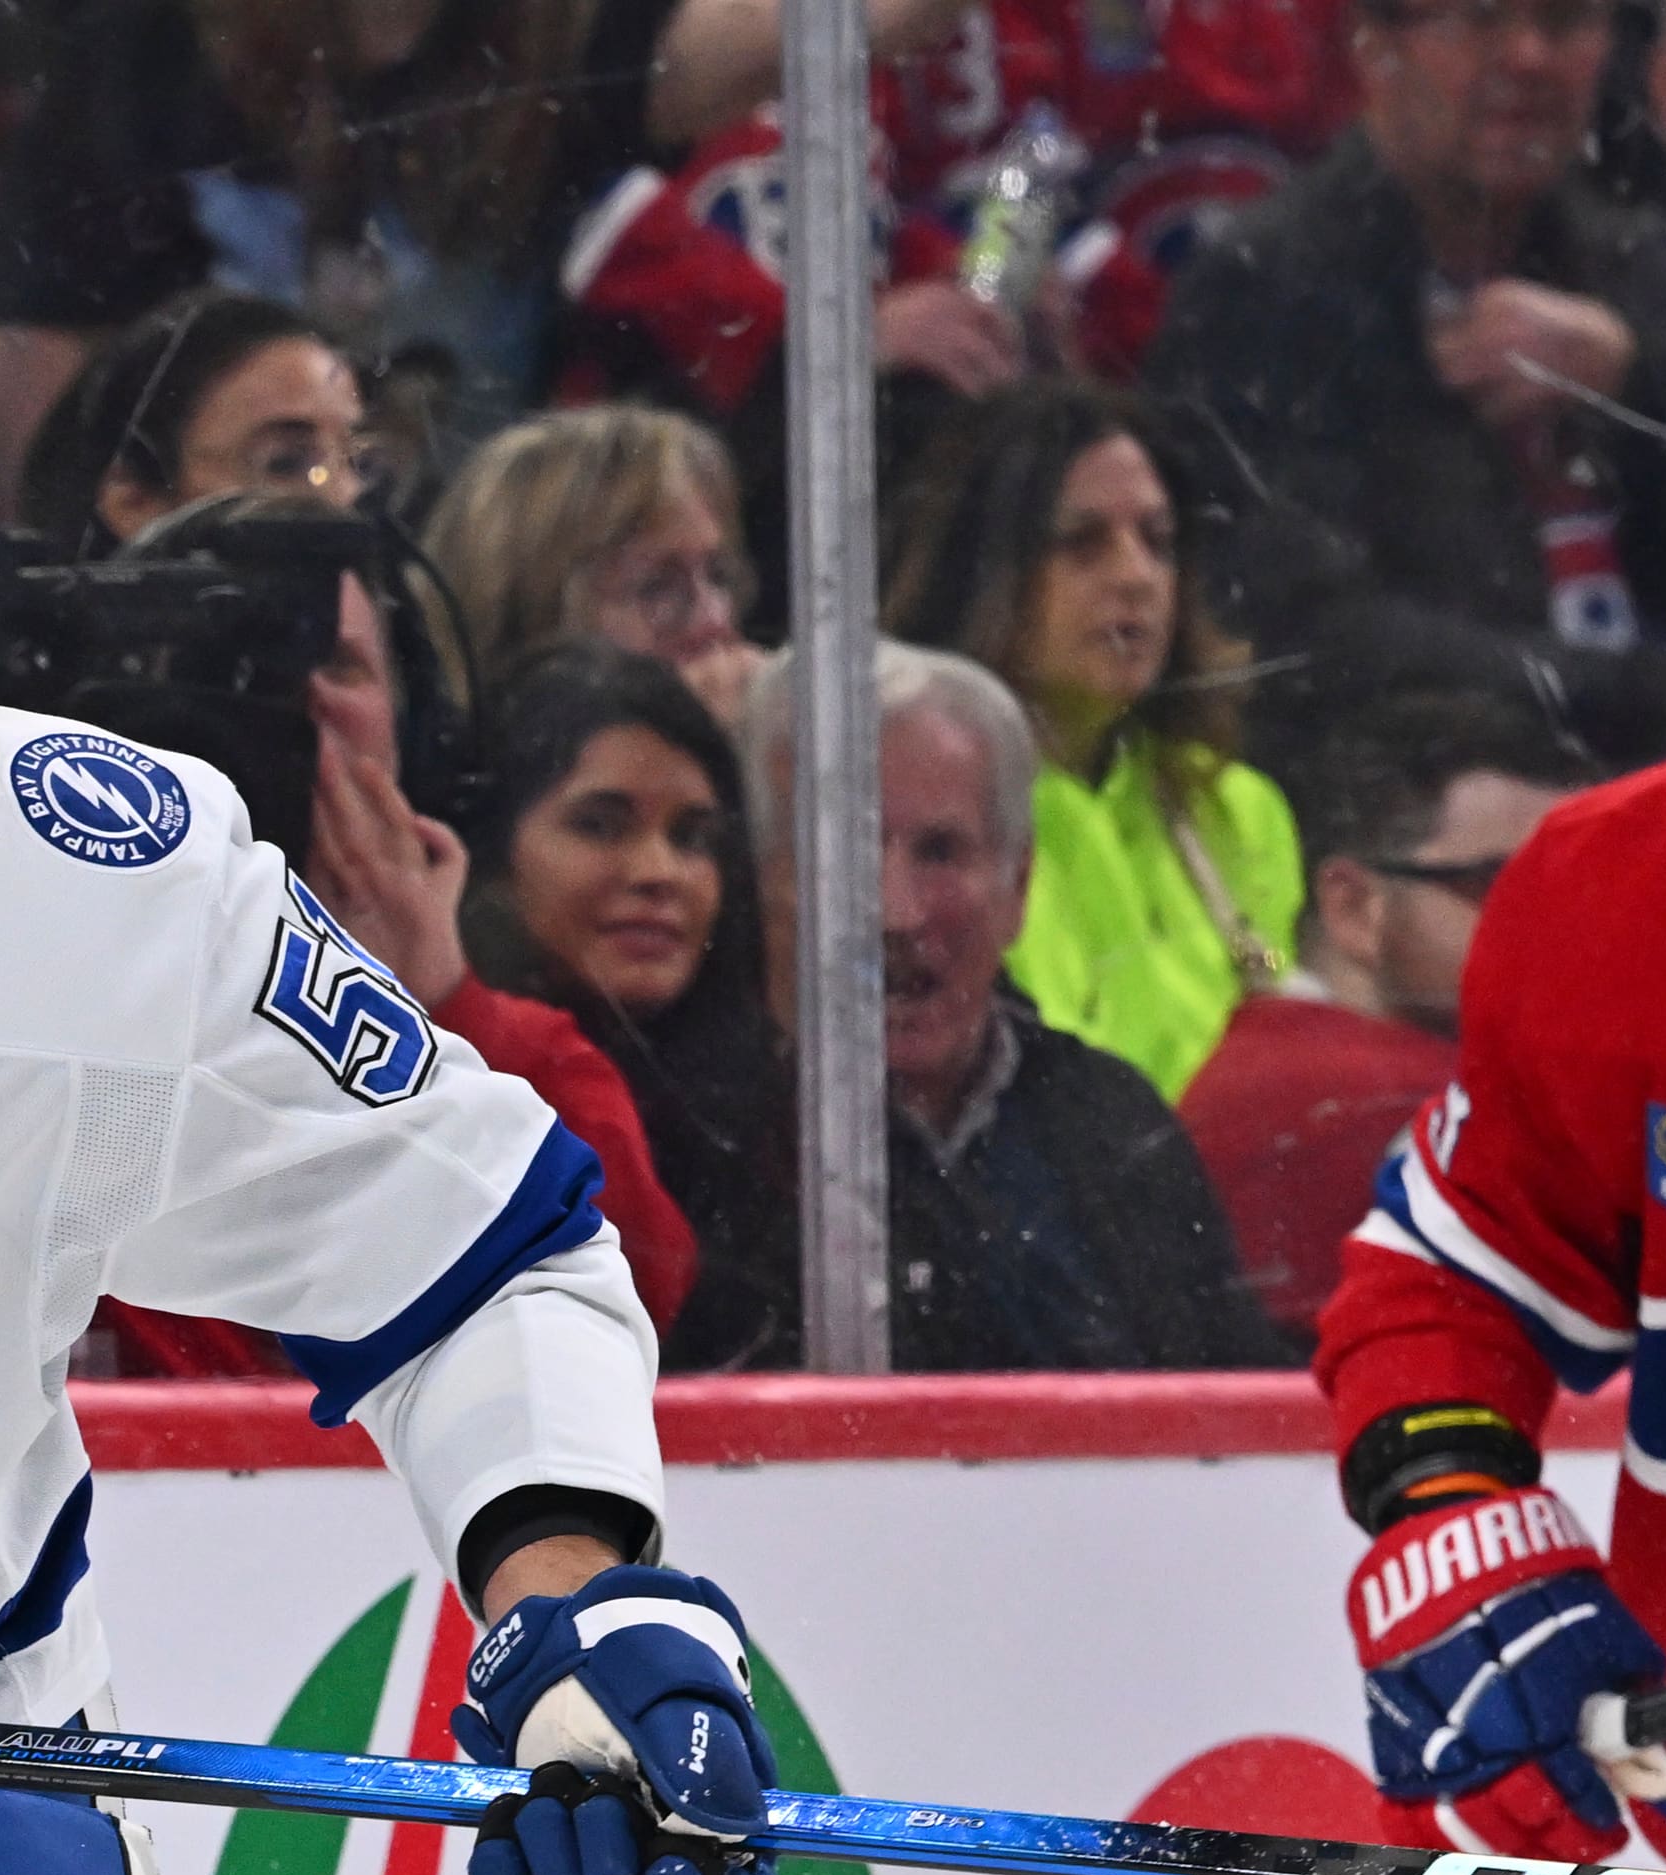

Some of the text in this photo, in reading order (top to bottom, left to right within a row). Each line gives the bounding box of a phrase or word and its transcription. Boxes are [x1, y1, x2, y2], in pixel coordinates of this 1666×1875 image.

[15, 735, 157, 861] TAMPA BAY LIGHTNING
[158, 792, 175, 831] HOCKEY
[171, 803, 186, 828] CLUB
[471, 1611, 523, 1683] CCM
[688, 1710, 710, 1775] CCM
